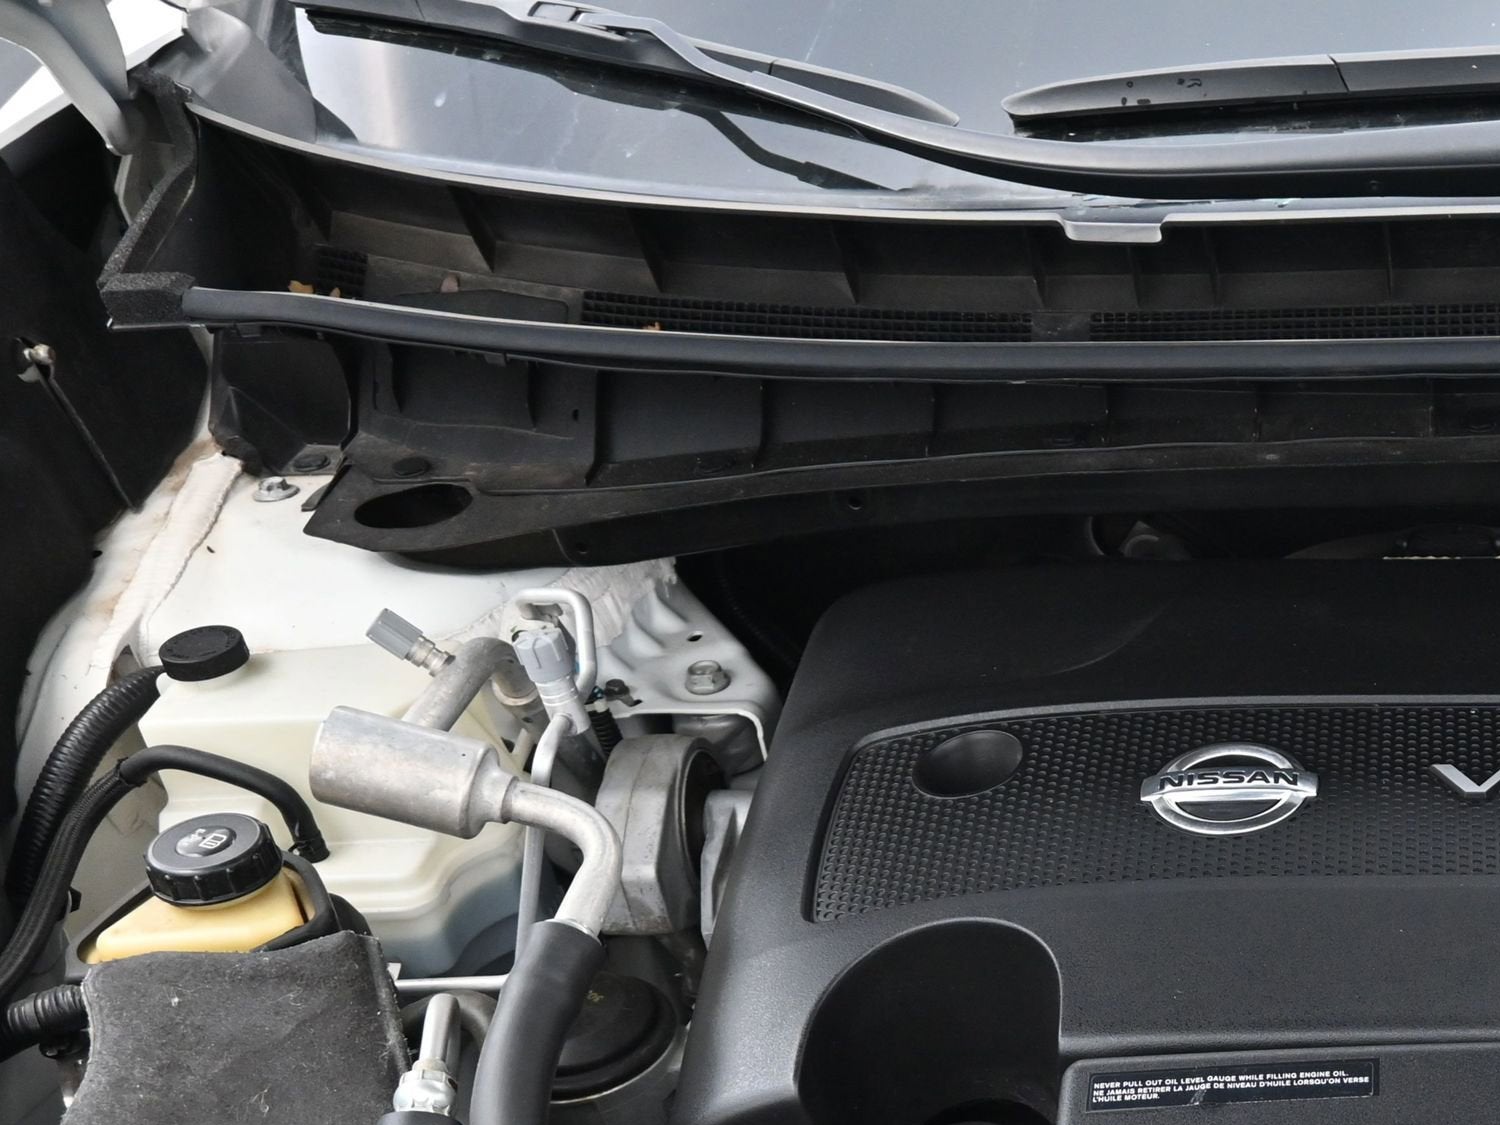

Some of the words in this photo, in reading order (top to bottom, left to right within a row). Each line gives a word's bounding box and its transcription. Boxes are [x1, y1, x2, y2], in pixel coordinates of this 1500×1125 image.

[1159, 770, 1299, 790] NISSAN
[1106, 1088, 1135, 1096] JAMAIS
[1173, 1084, 1183, 1092] LA
[1185, 1083, 1211, 1091] JAUGE
[1227, 1081, 1257, 1089] NIVEAU
[1293, 1078, 1340, 1086] LORSQU'ON
[1093, 1095, 1122, 1103] L'HUILE
[1124, 1093, 1160, 1101] MOTEUR.
